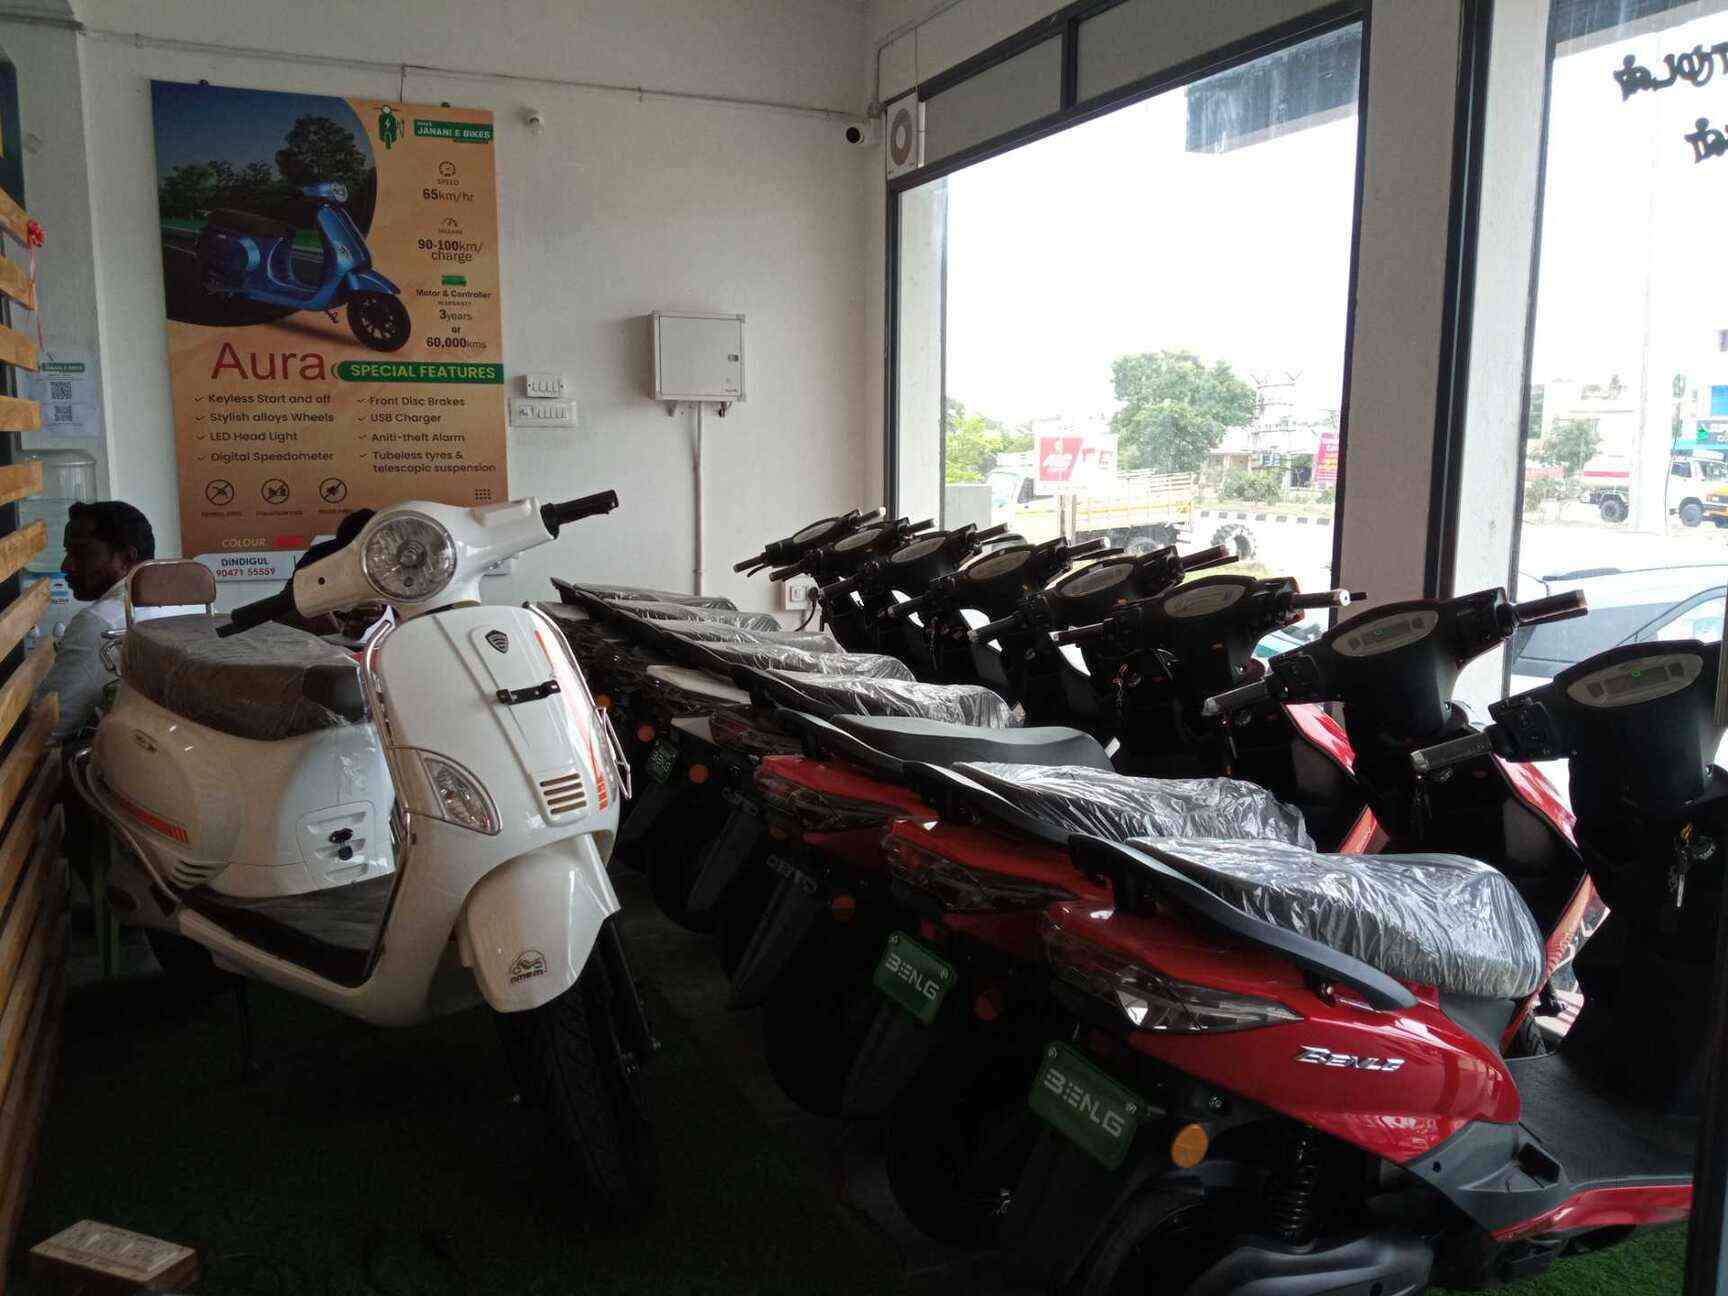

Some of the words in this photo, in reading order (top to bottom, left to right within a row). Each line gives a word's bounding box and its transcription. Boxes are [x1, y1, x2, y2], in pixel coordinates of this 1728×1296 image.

[422, 188, 476, 202] 65km/hr
[431, 251, 473, 264] charge
[416, 289, 440, 297] Motor
[451, 290, 491, 299] Controller
[451, 326, 461, 334] or
[210, 342, 326, 381] Aura
[351, 364, 415, 378] SPECIAL
[419, 366, 496, 379] FEATURES
[208, 394, 255, 404] Keyless
[256, 394, 286, 403] Start
[288, 394, 313, 403] and
[315, 395, 331, 404] off
[369, 396, 398, 406] Front
[401, 397, 424, 406] Disc
[427, 397, 465, 407] Brakes
[210, 412, 250, 423] Stylish
[252, 413, 288, 423] alloys
[291, 413, 334, 422] Wheels
[370, 413, 392, 422] USB
[394, 413, 441, 424] Charger
[210, 432, 231, 441] LED
[234, 432, 266, 441] Head
[268, 432, 299, 443] Light
[432, 432, 465, 442] Alarm
[210, 452, 250, 464] Digital
[252, 452, 334, 463] Speedometer
[373, 451, 422, 460] Tubeless
[425, 452, 453, 461] tyres
[455, 452, 464, 460] &
[373, 464, 432, 474] telescopic
[433, 465, 496, 474] suspension
[221, 537, 267, 549] COLOUR
